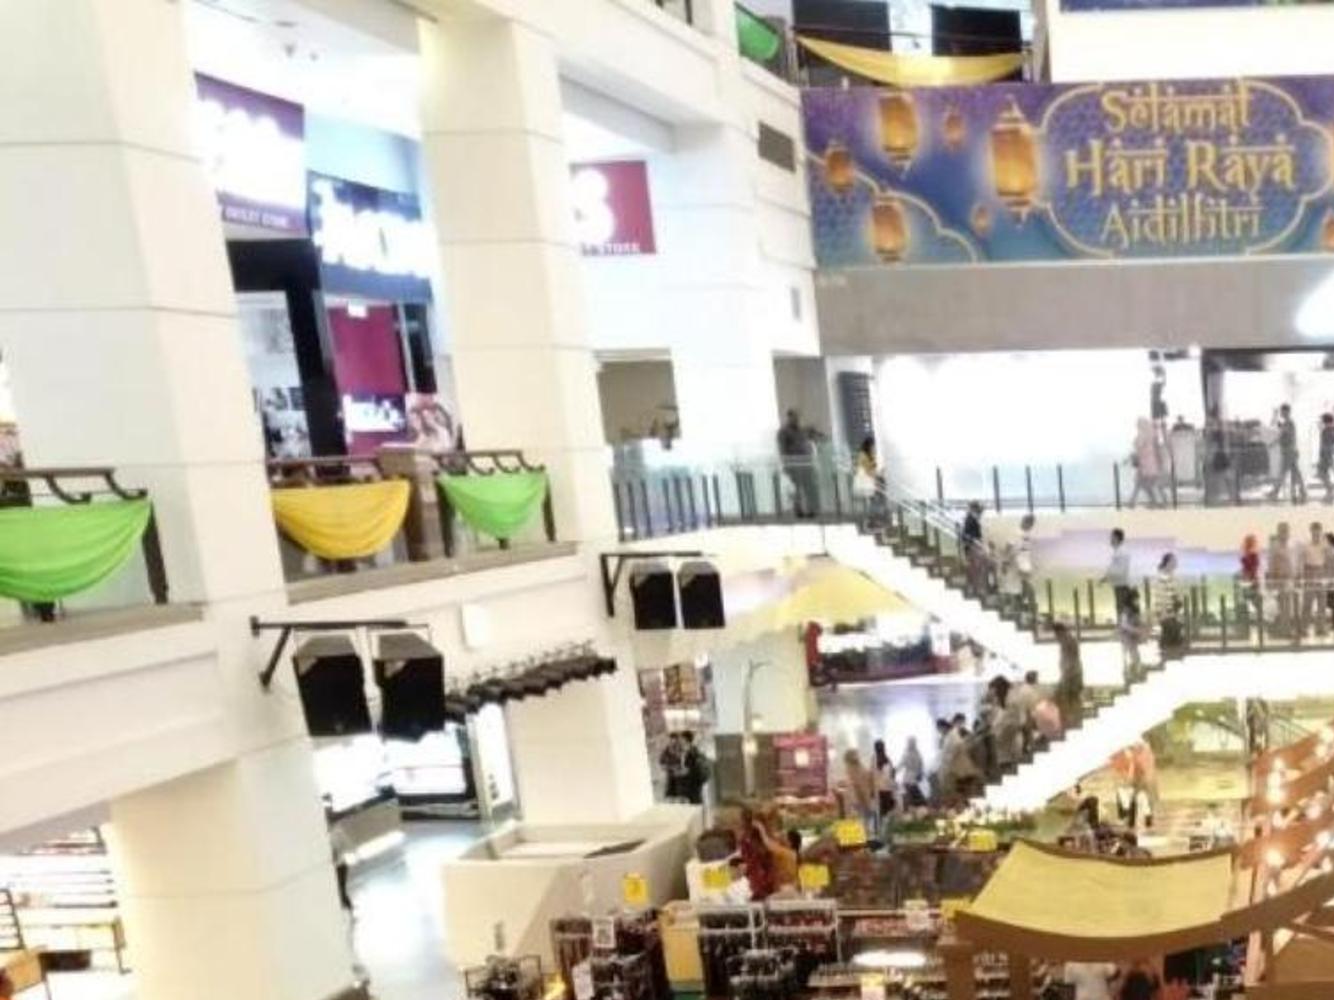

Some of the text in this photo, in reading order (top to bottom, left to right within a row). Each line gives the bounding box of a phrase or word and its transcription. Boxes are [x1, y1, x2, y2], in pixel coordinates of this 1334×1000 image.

[1102, 83, 1253, 132] Selamat
[1064, 133, 1298, 200] Hari Raya
[1100, 192, 1260, 249] Aidilfitri
